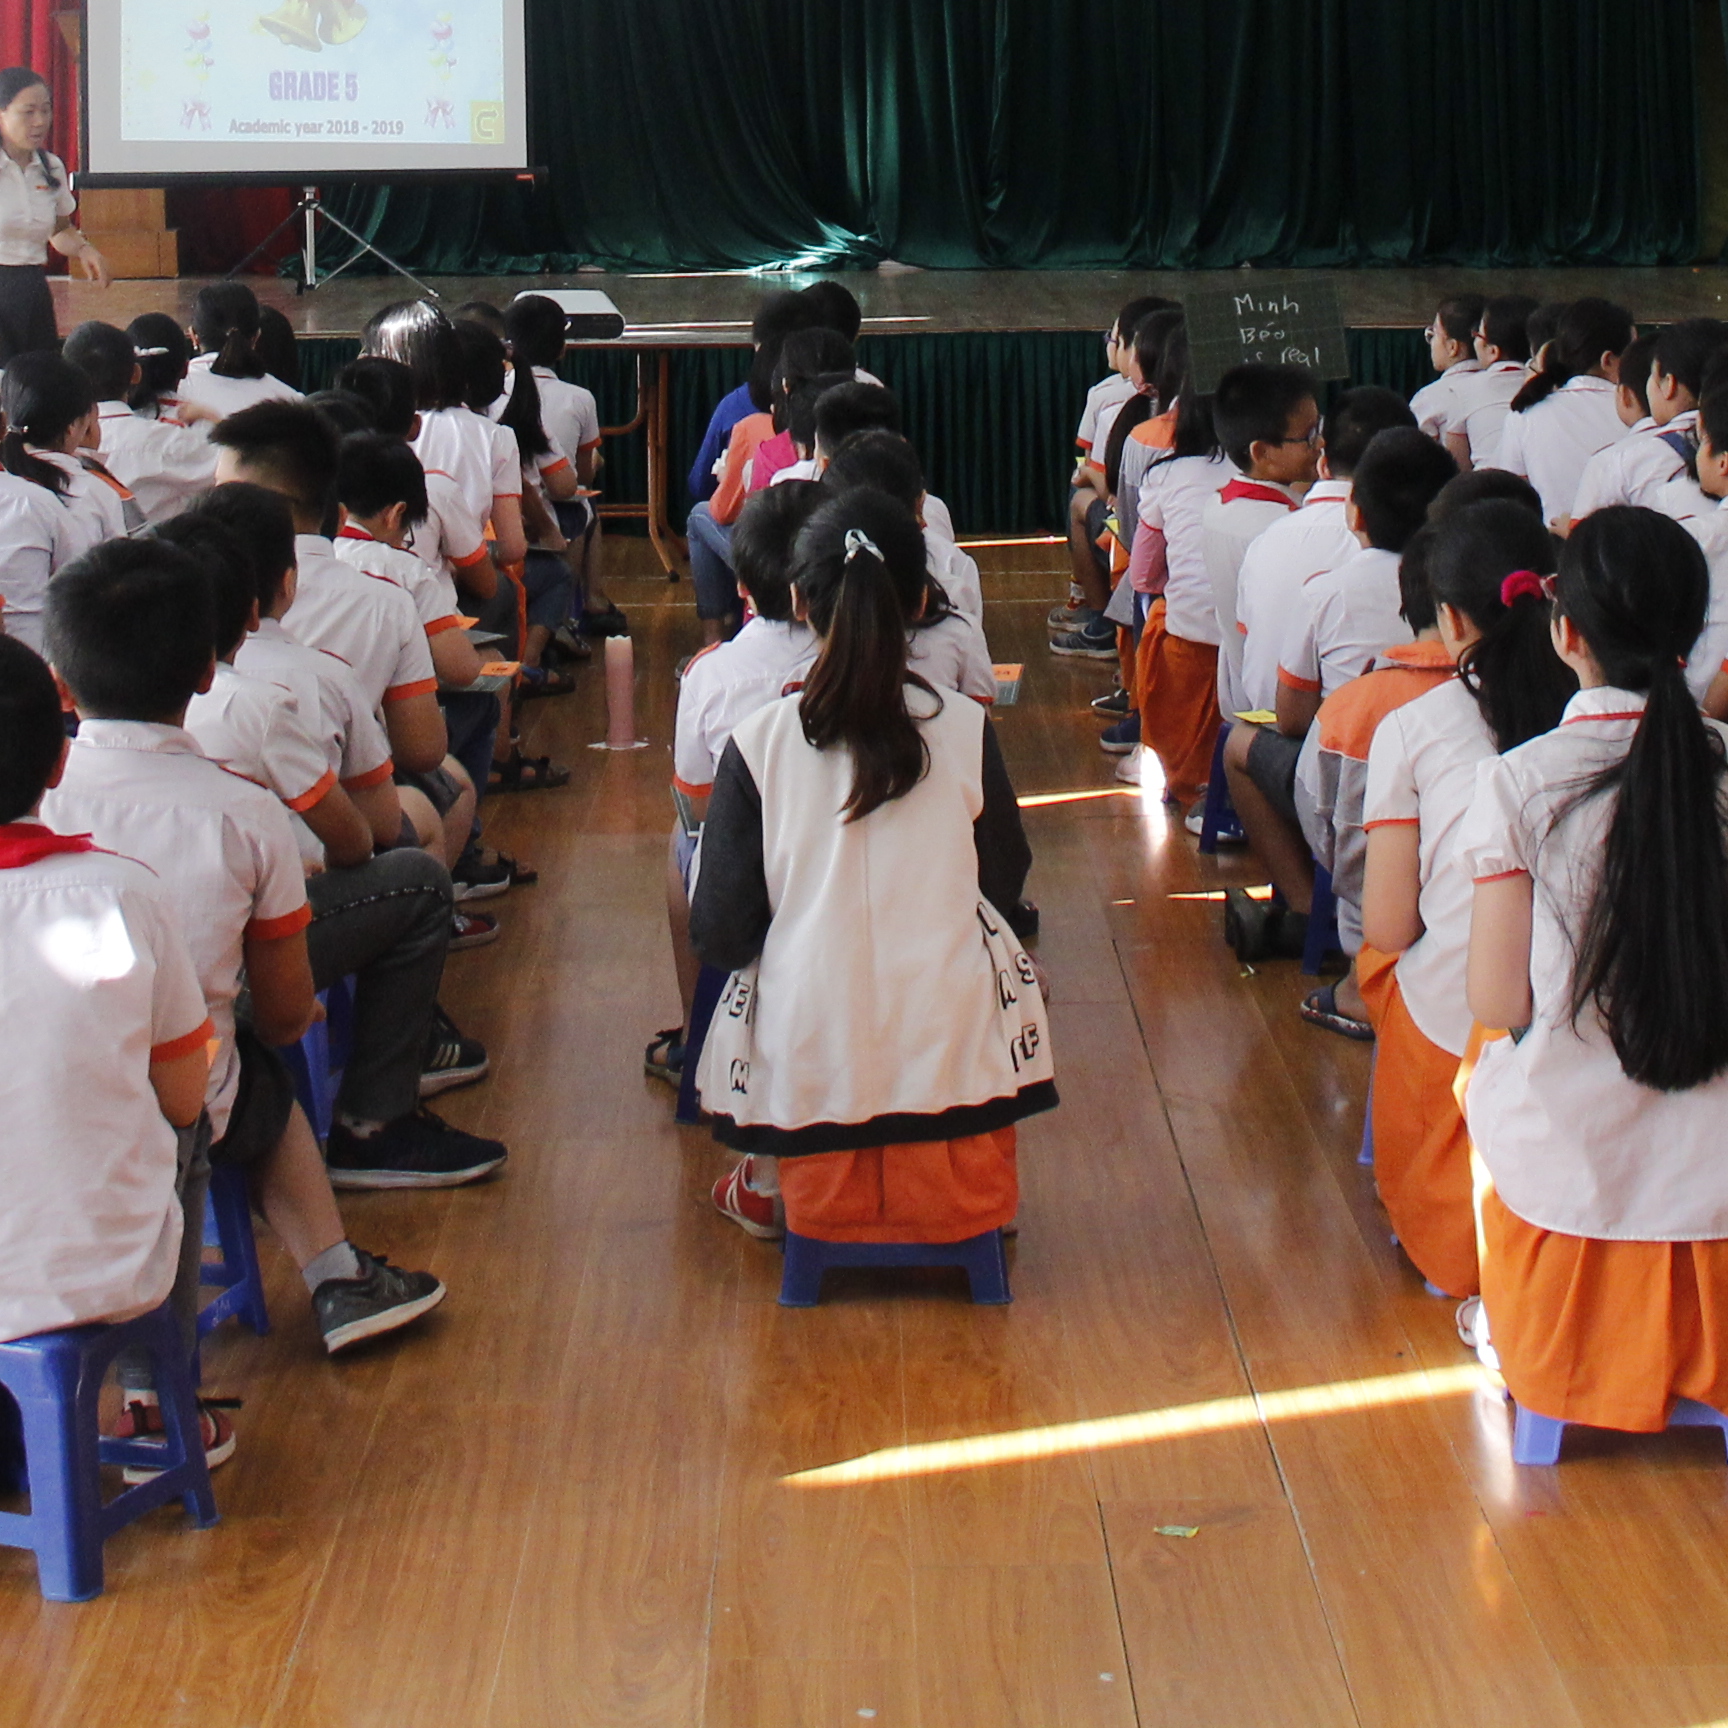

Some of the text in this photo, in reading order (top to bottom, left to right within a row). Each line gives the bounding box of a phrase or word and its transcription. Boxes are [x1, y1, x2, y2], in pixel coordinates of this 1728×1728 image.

[269, 71, 359, 101] GRADE 5
[229, 119, 291, 135] Academic
[295, 123, 323, 139] year
[326, 119, 359, 135] 2018
[372, 120, 404, 135] 2019
[1234, 293, 1299, 315] Minh
[1281, 346, 1320, 367] real
